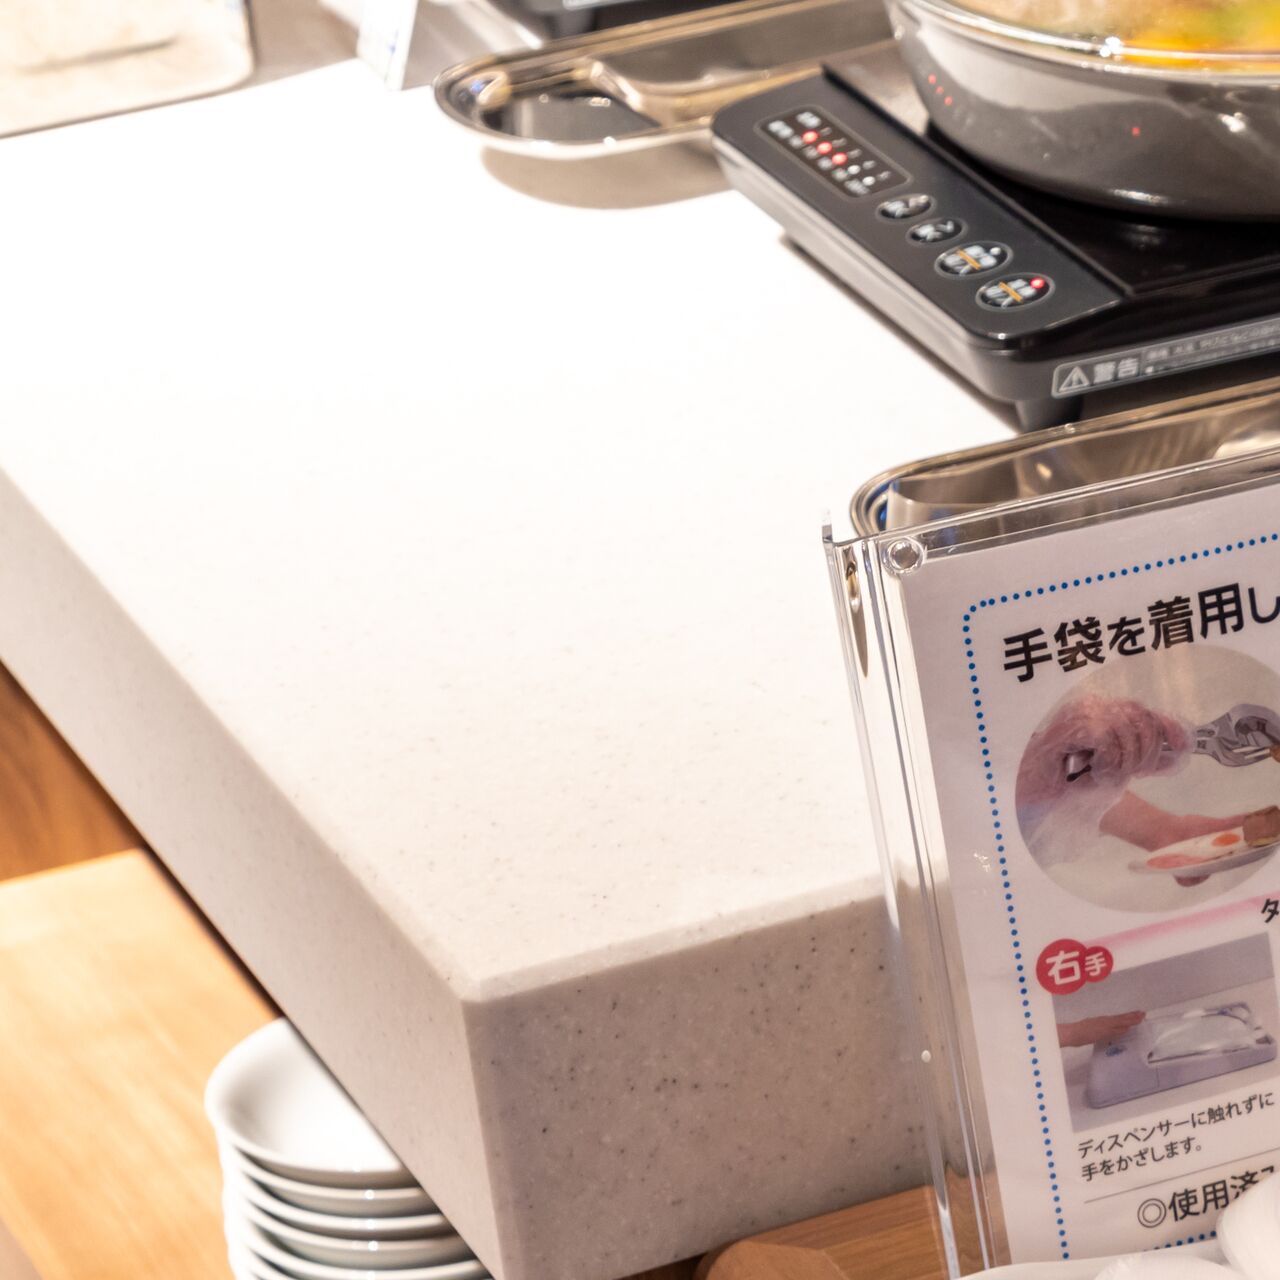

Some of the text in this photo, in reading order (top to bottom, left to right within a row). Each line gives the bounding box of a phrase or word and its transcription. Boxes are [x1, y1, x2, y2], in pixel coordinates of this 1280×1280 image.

[1045, 950, 1108, 986] 右手
[1077, 1092, 1276, 1160] ディスペンサーに触れずに
[1080, 1136, 1202, 1182] 手をかざします。
